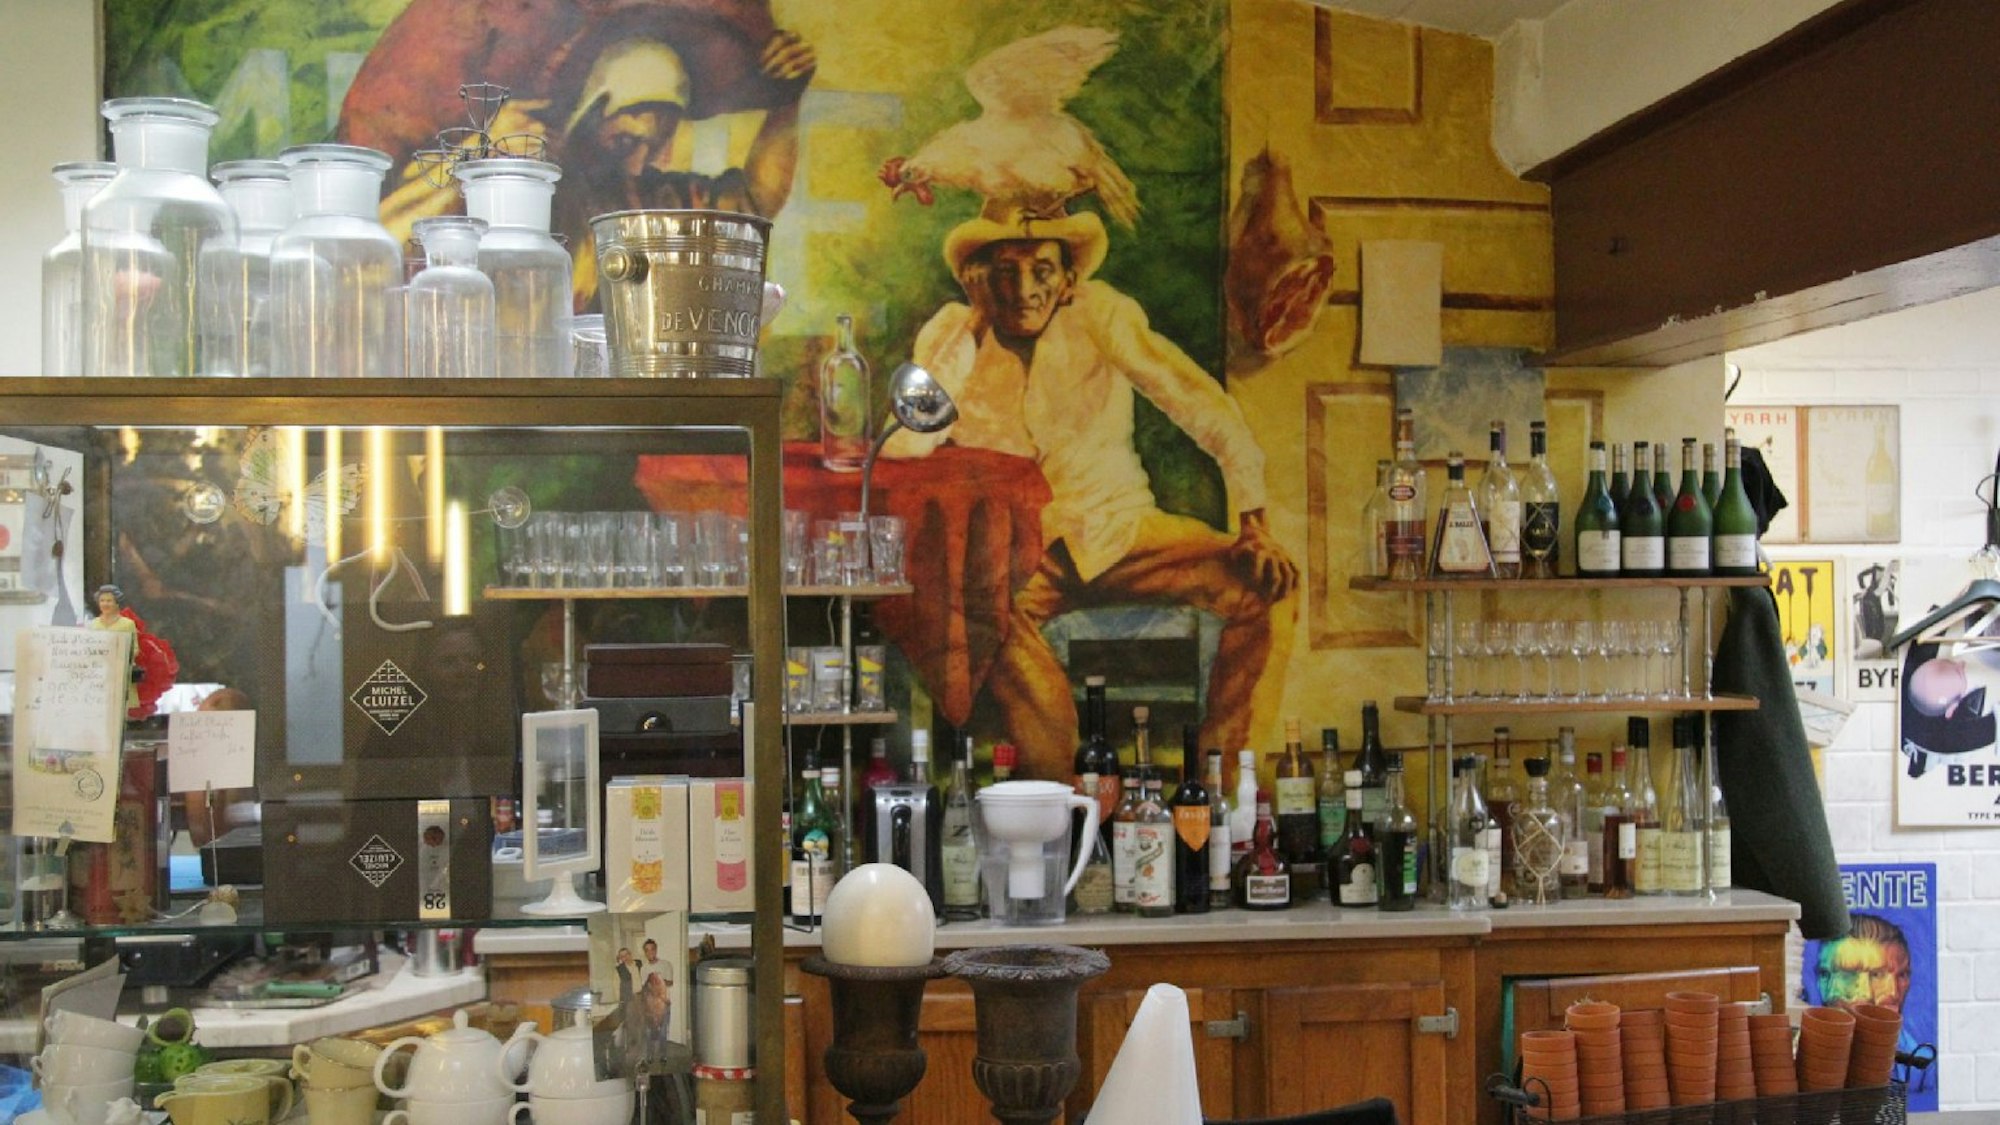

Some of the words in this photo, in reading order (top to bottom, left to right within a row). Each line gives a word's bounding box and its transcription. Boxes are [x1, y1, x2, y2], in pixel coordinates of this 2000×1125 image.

[661, 311, 684, 331] DE
[371, 686, 408, 695] MICHEL
[362, 696, 415, 707] CLUIZEL
[1948, 764, 2000, 786] BER
[359, 853, 396, 863] CLUIZEL
[423, 893, 446, 910] 28
